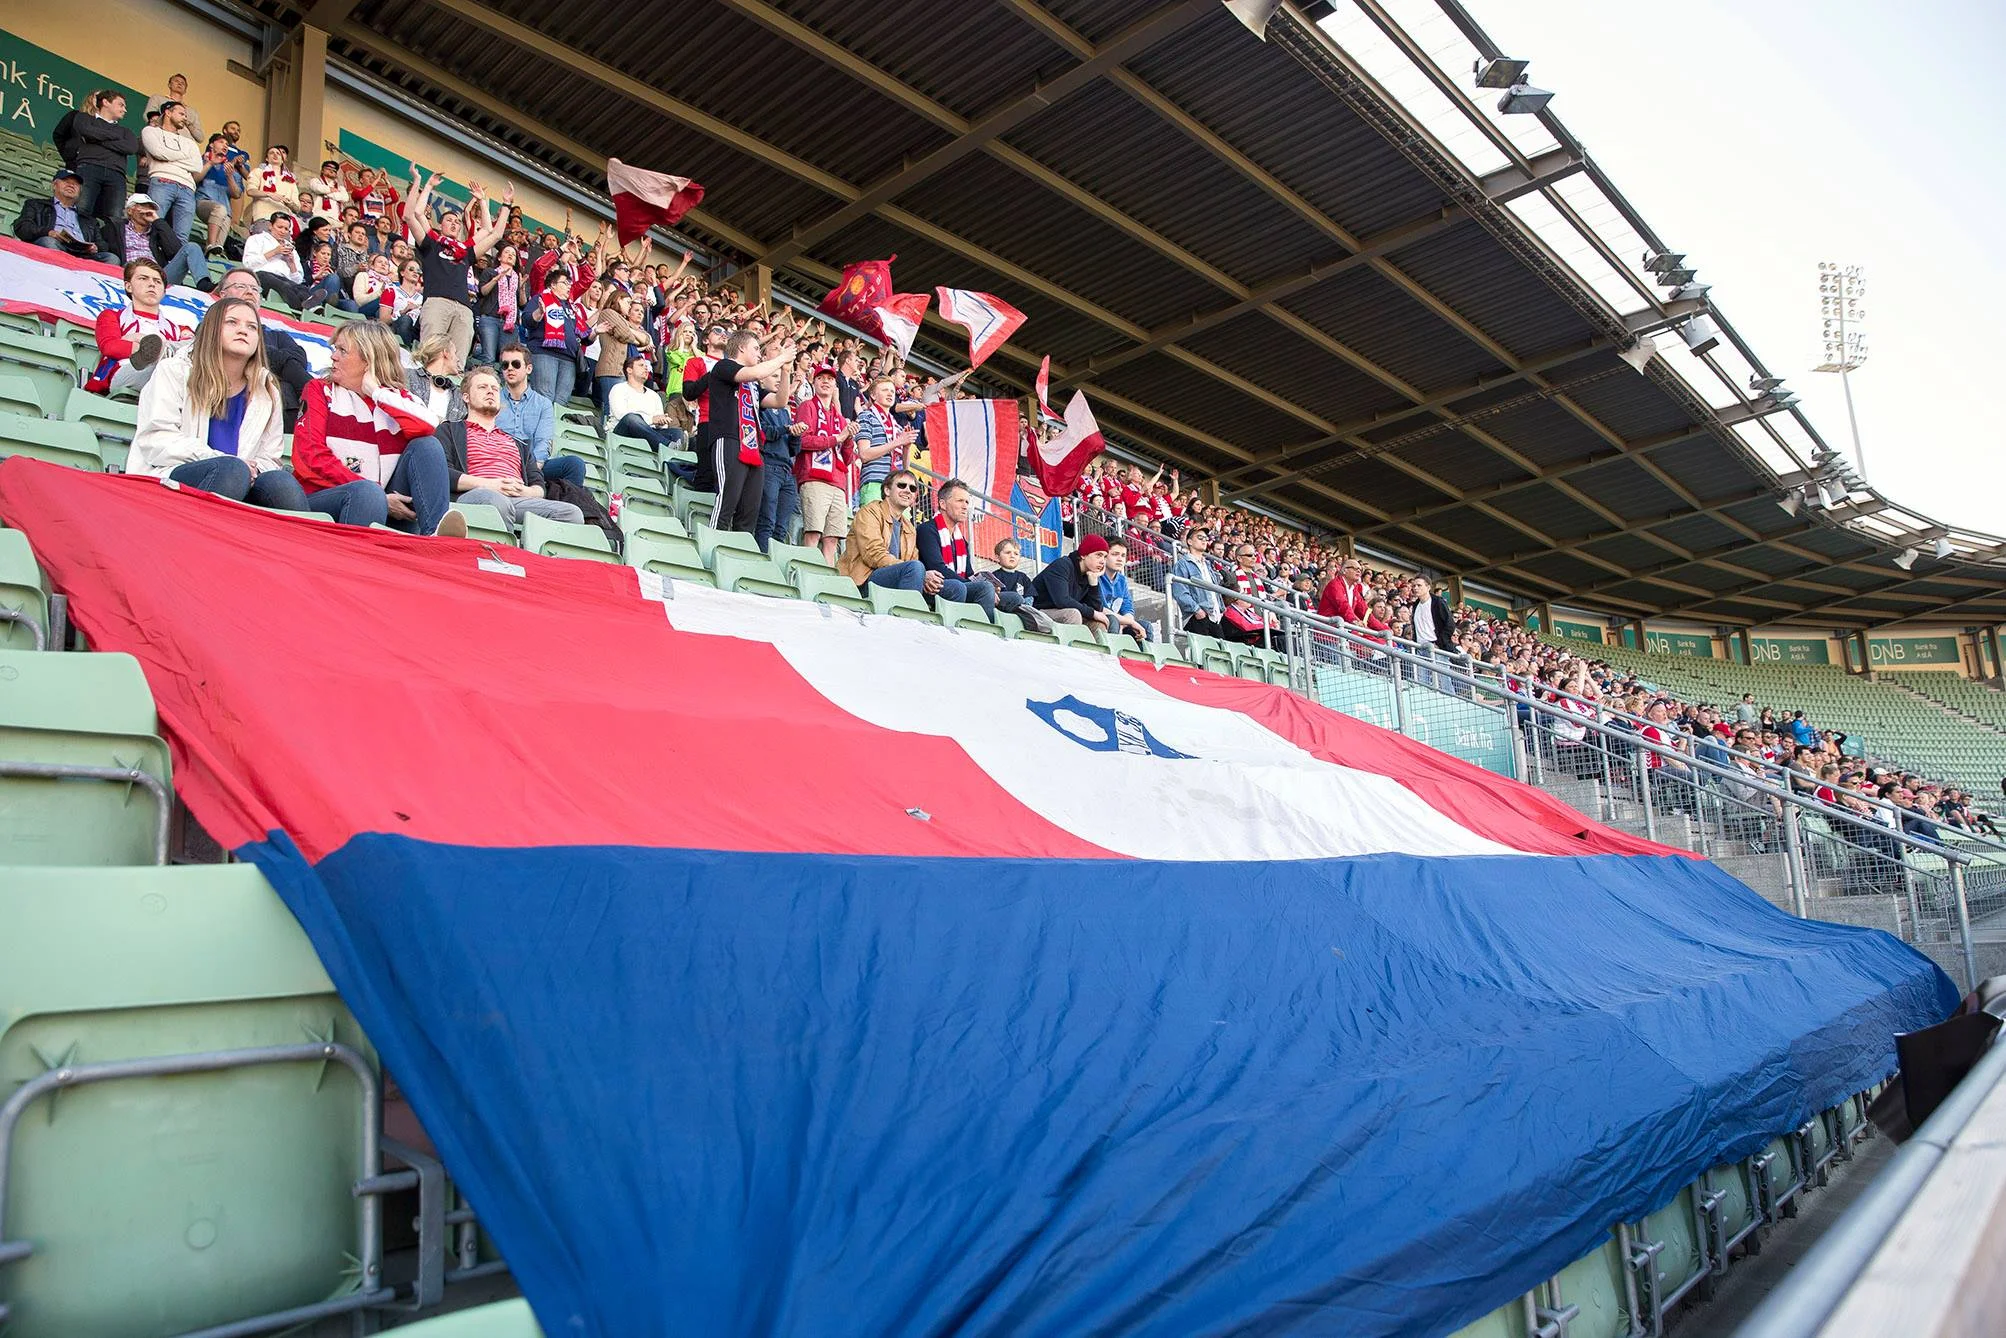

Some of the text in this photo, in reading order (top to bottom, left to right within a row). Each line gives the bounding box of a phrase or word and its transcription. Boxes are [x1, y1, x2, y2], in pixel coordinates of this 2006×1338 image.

[37, 73, 75, 109] fra
[12, 97, 36, 128] Å
[1870, 638, 1905, 665] DNB
